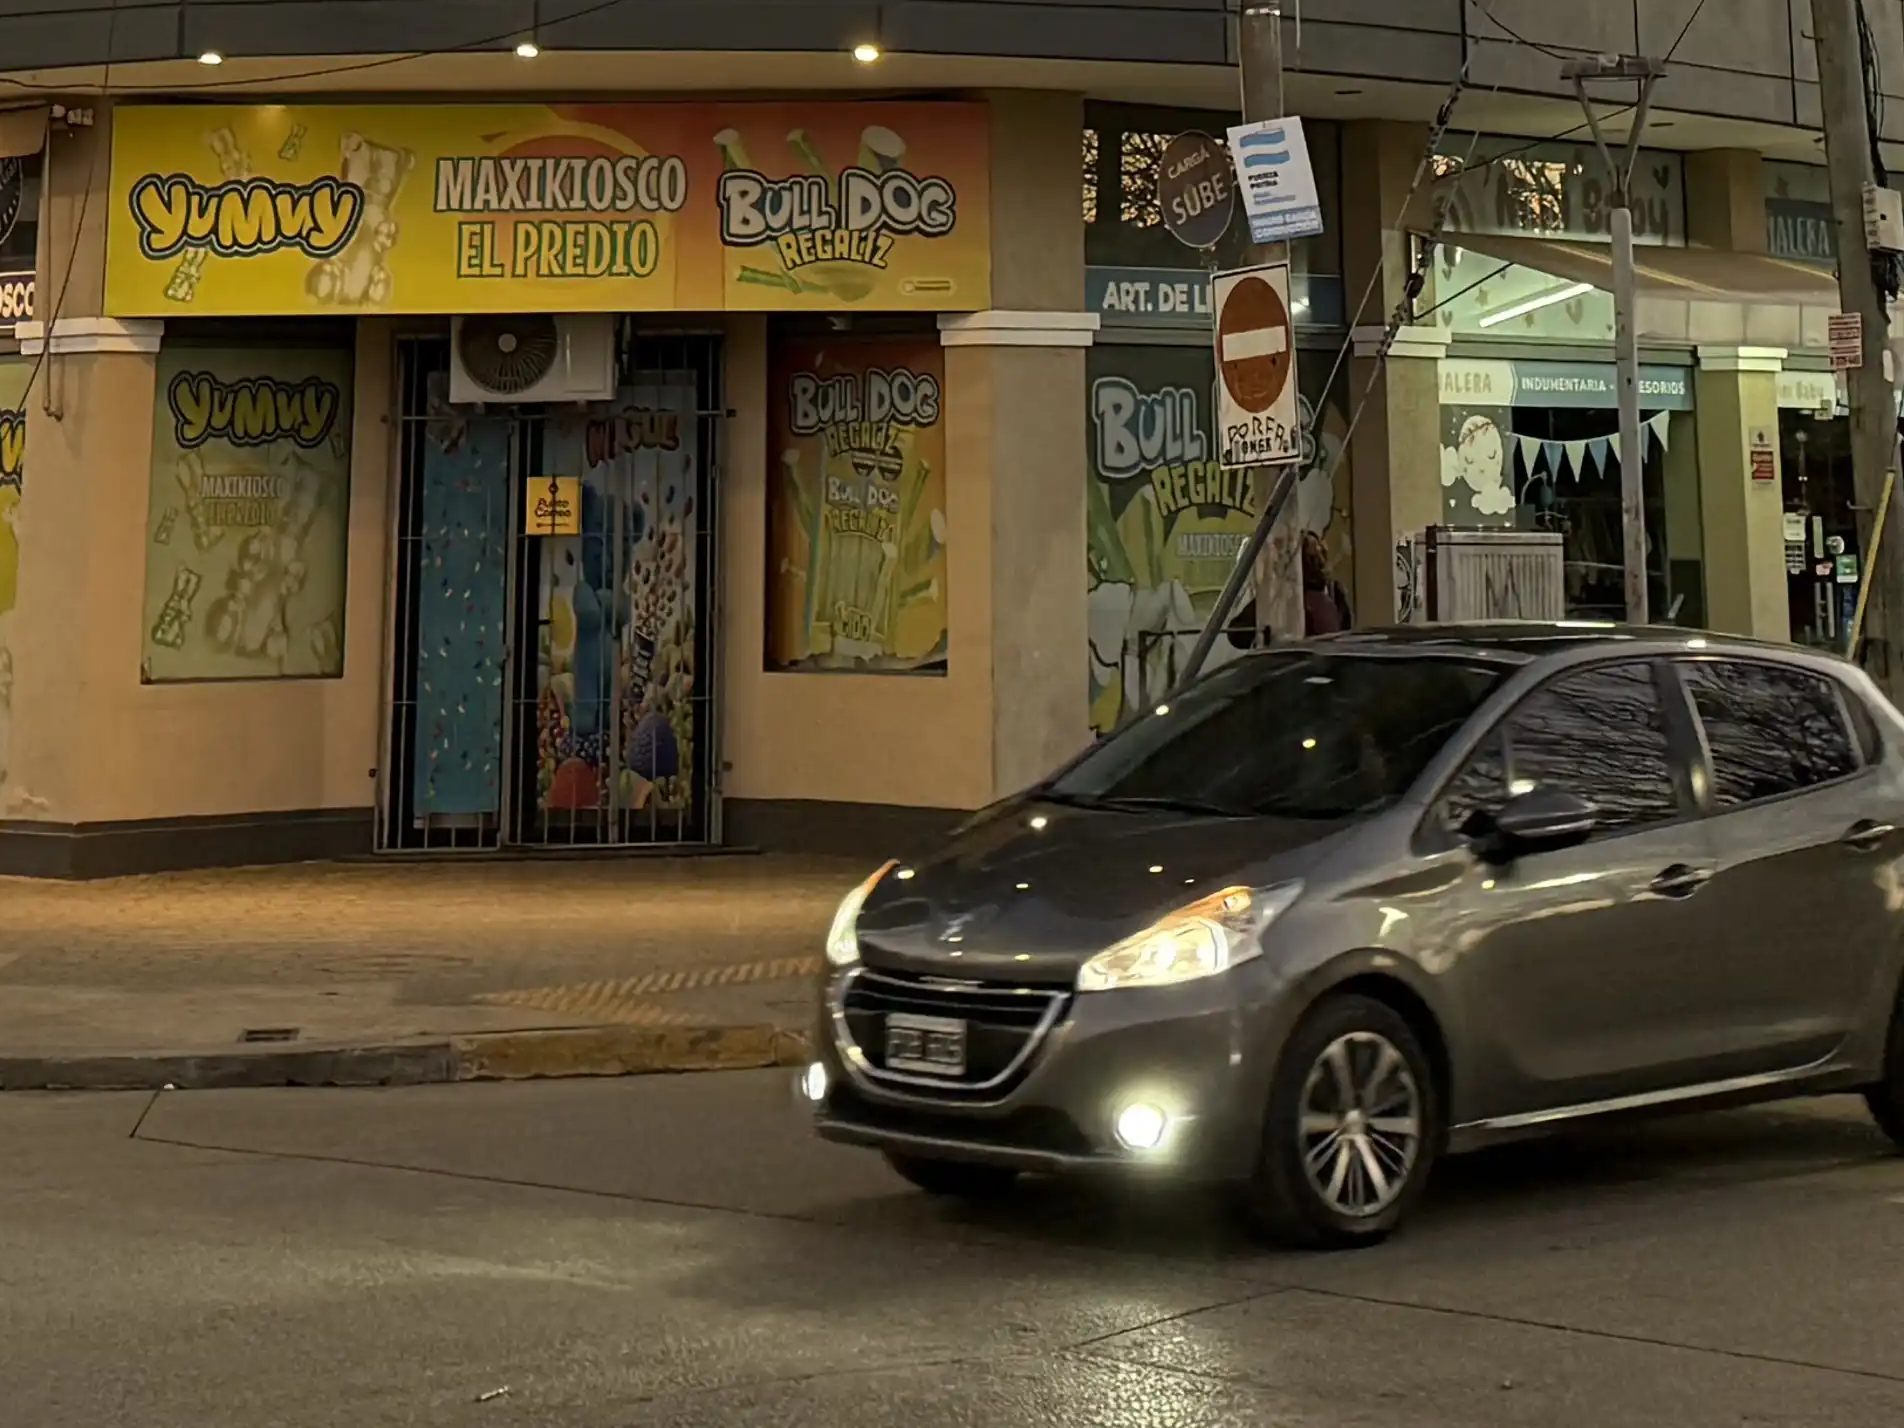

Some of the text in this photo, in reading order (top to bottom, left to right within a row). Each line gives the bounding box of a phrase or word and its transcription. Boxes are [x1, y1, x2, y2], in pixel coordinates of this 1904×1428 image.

[434, 156, 688, 213] MAXIKIOSCO
[1172, 174, 1227, 226] SUBE
[457, 220, 660, 278] EL PREDIO
[1102, 281, 1153, 312] ART.
[1158, 283, 1189, 312] DE
[1521, 375, 1607, 393] INDUMENTARIA
